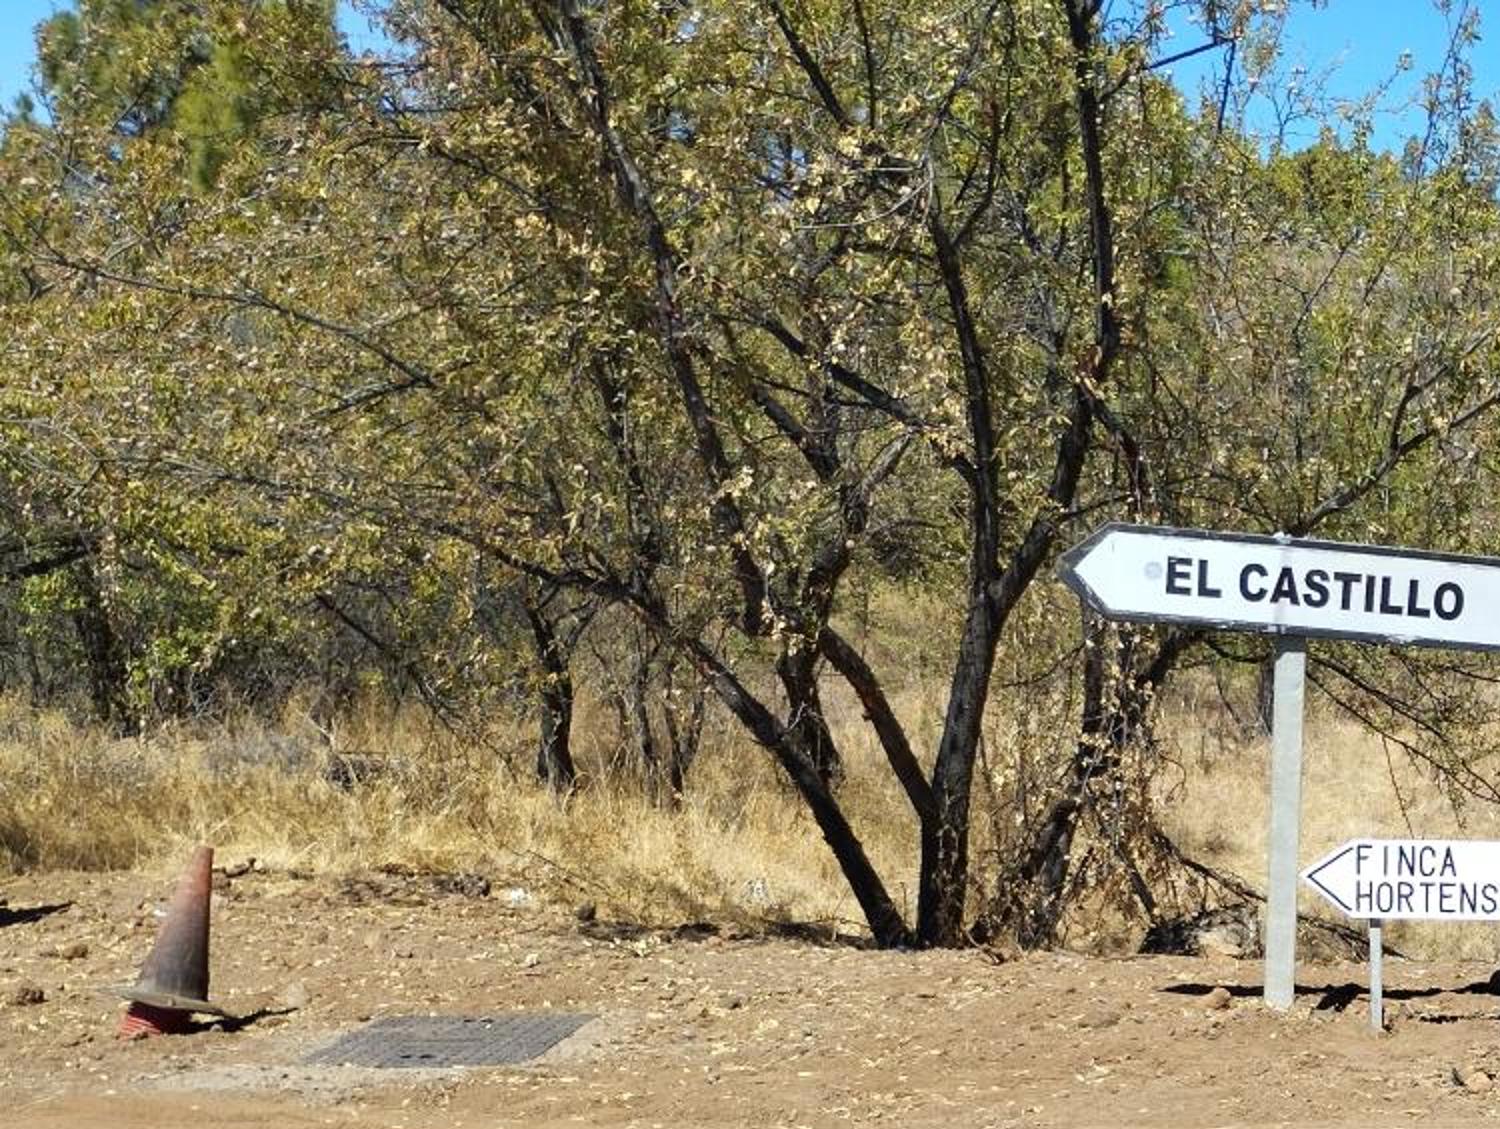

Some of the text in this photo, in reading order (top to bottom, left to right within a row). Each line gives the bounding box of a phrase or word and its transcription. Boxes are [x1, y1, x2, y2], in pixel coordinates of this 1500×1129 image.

[1164, 555, 1466, 621] EL CASTILLO
[1355, 844, 1457, 877] FINCA
